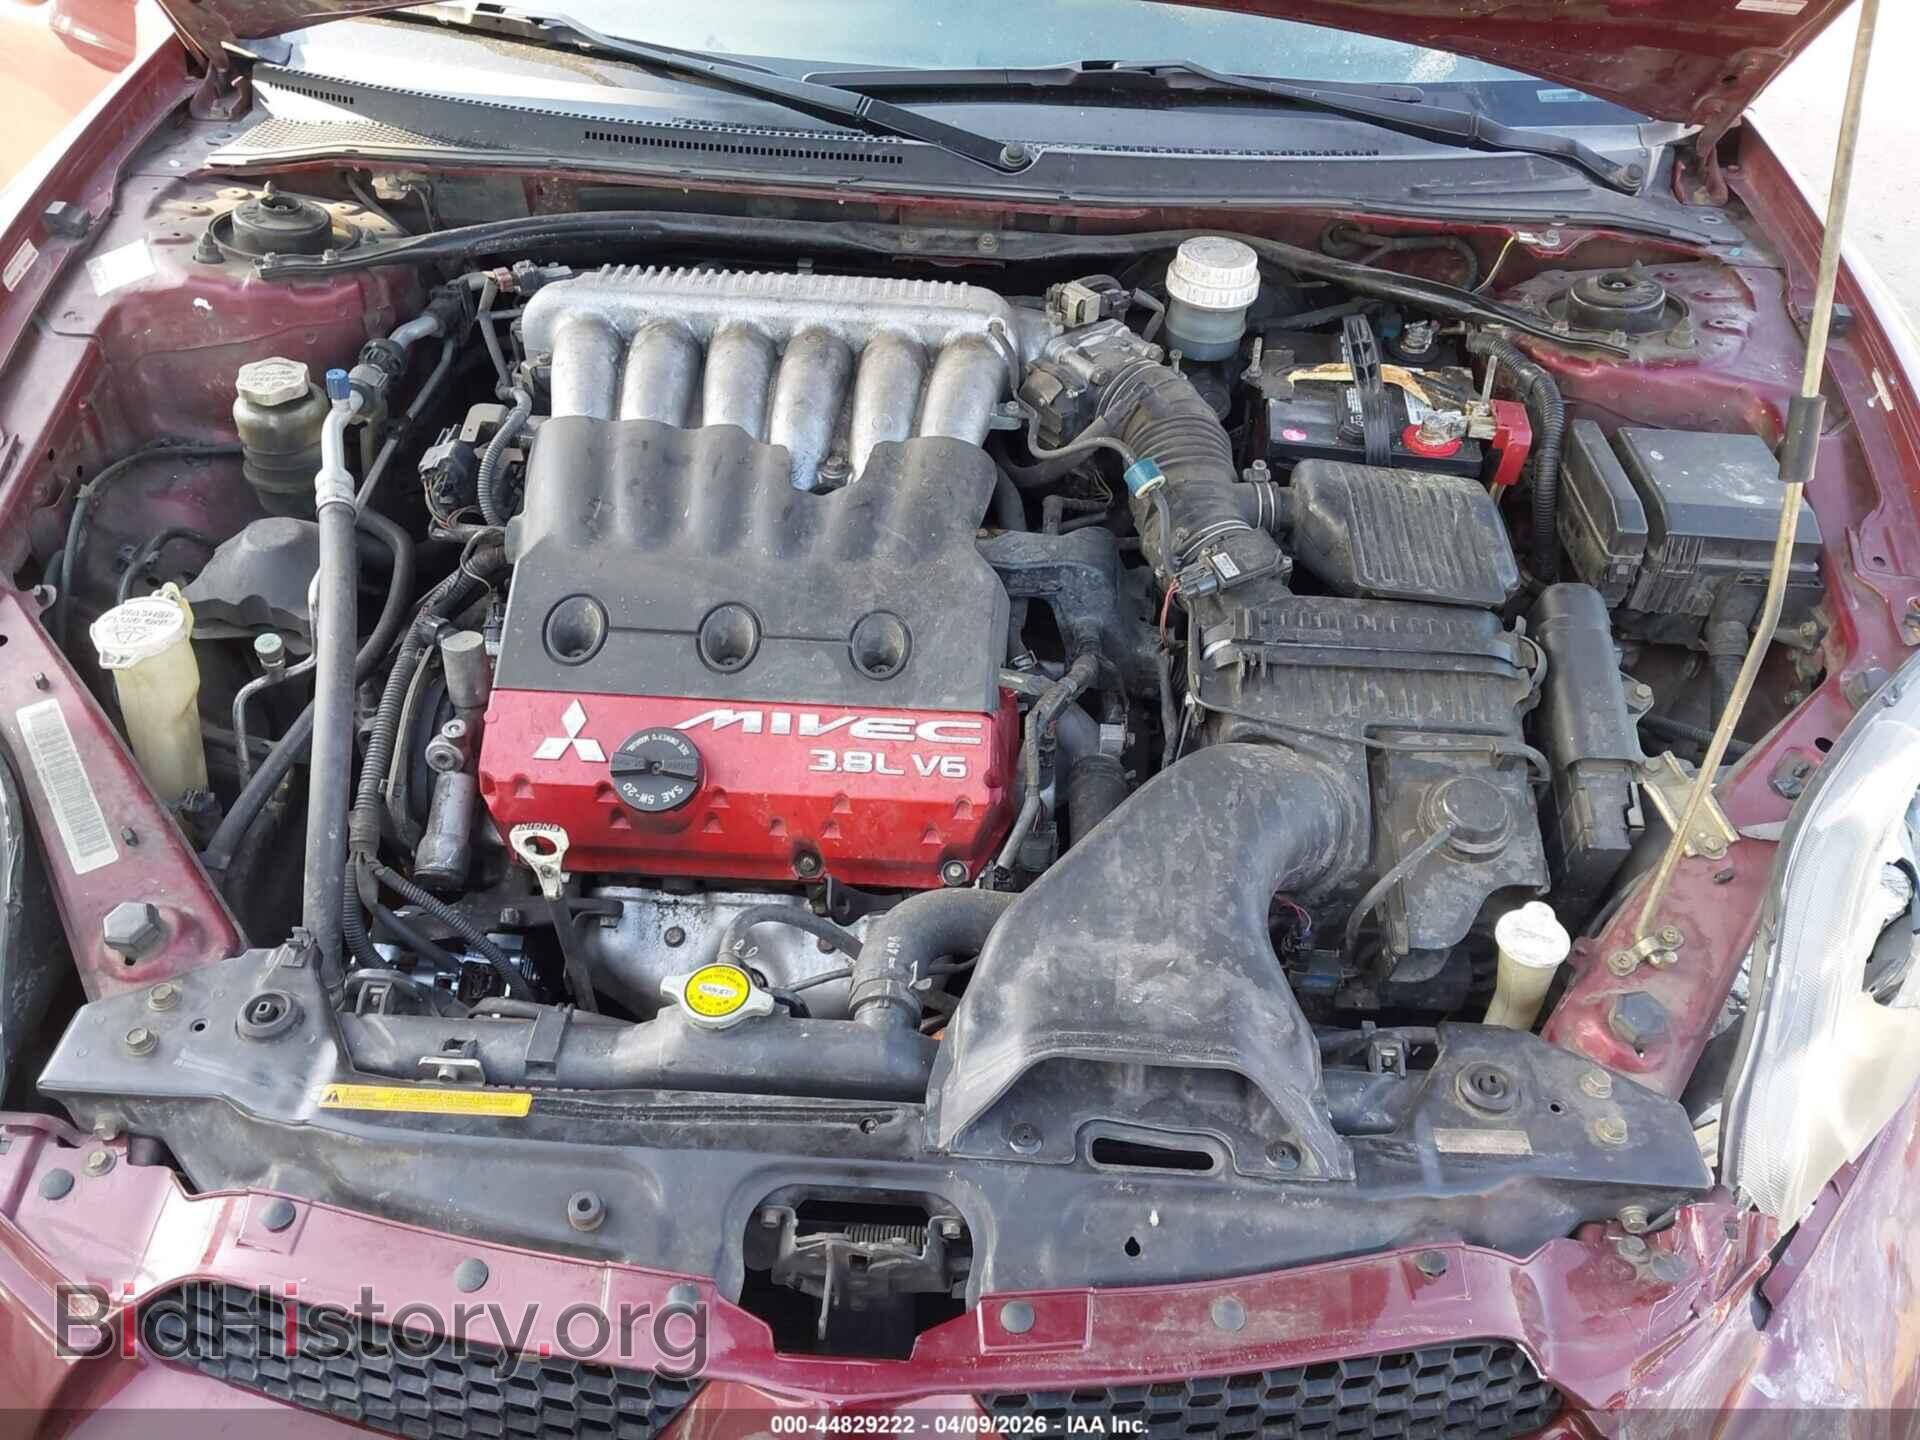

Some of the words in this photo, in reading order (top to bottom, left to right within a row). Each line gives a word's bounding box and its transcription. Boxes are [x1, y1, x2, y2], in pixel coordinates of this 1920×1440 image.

[672, 708, 982, 745] MIVEC
[808, 749, 905, 776] 3.8L
[911, 753, 968, 778] V6
[622, 782, 656, 805] 5W-20
[660, 784, 684, 804] SAE
